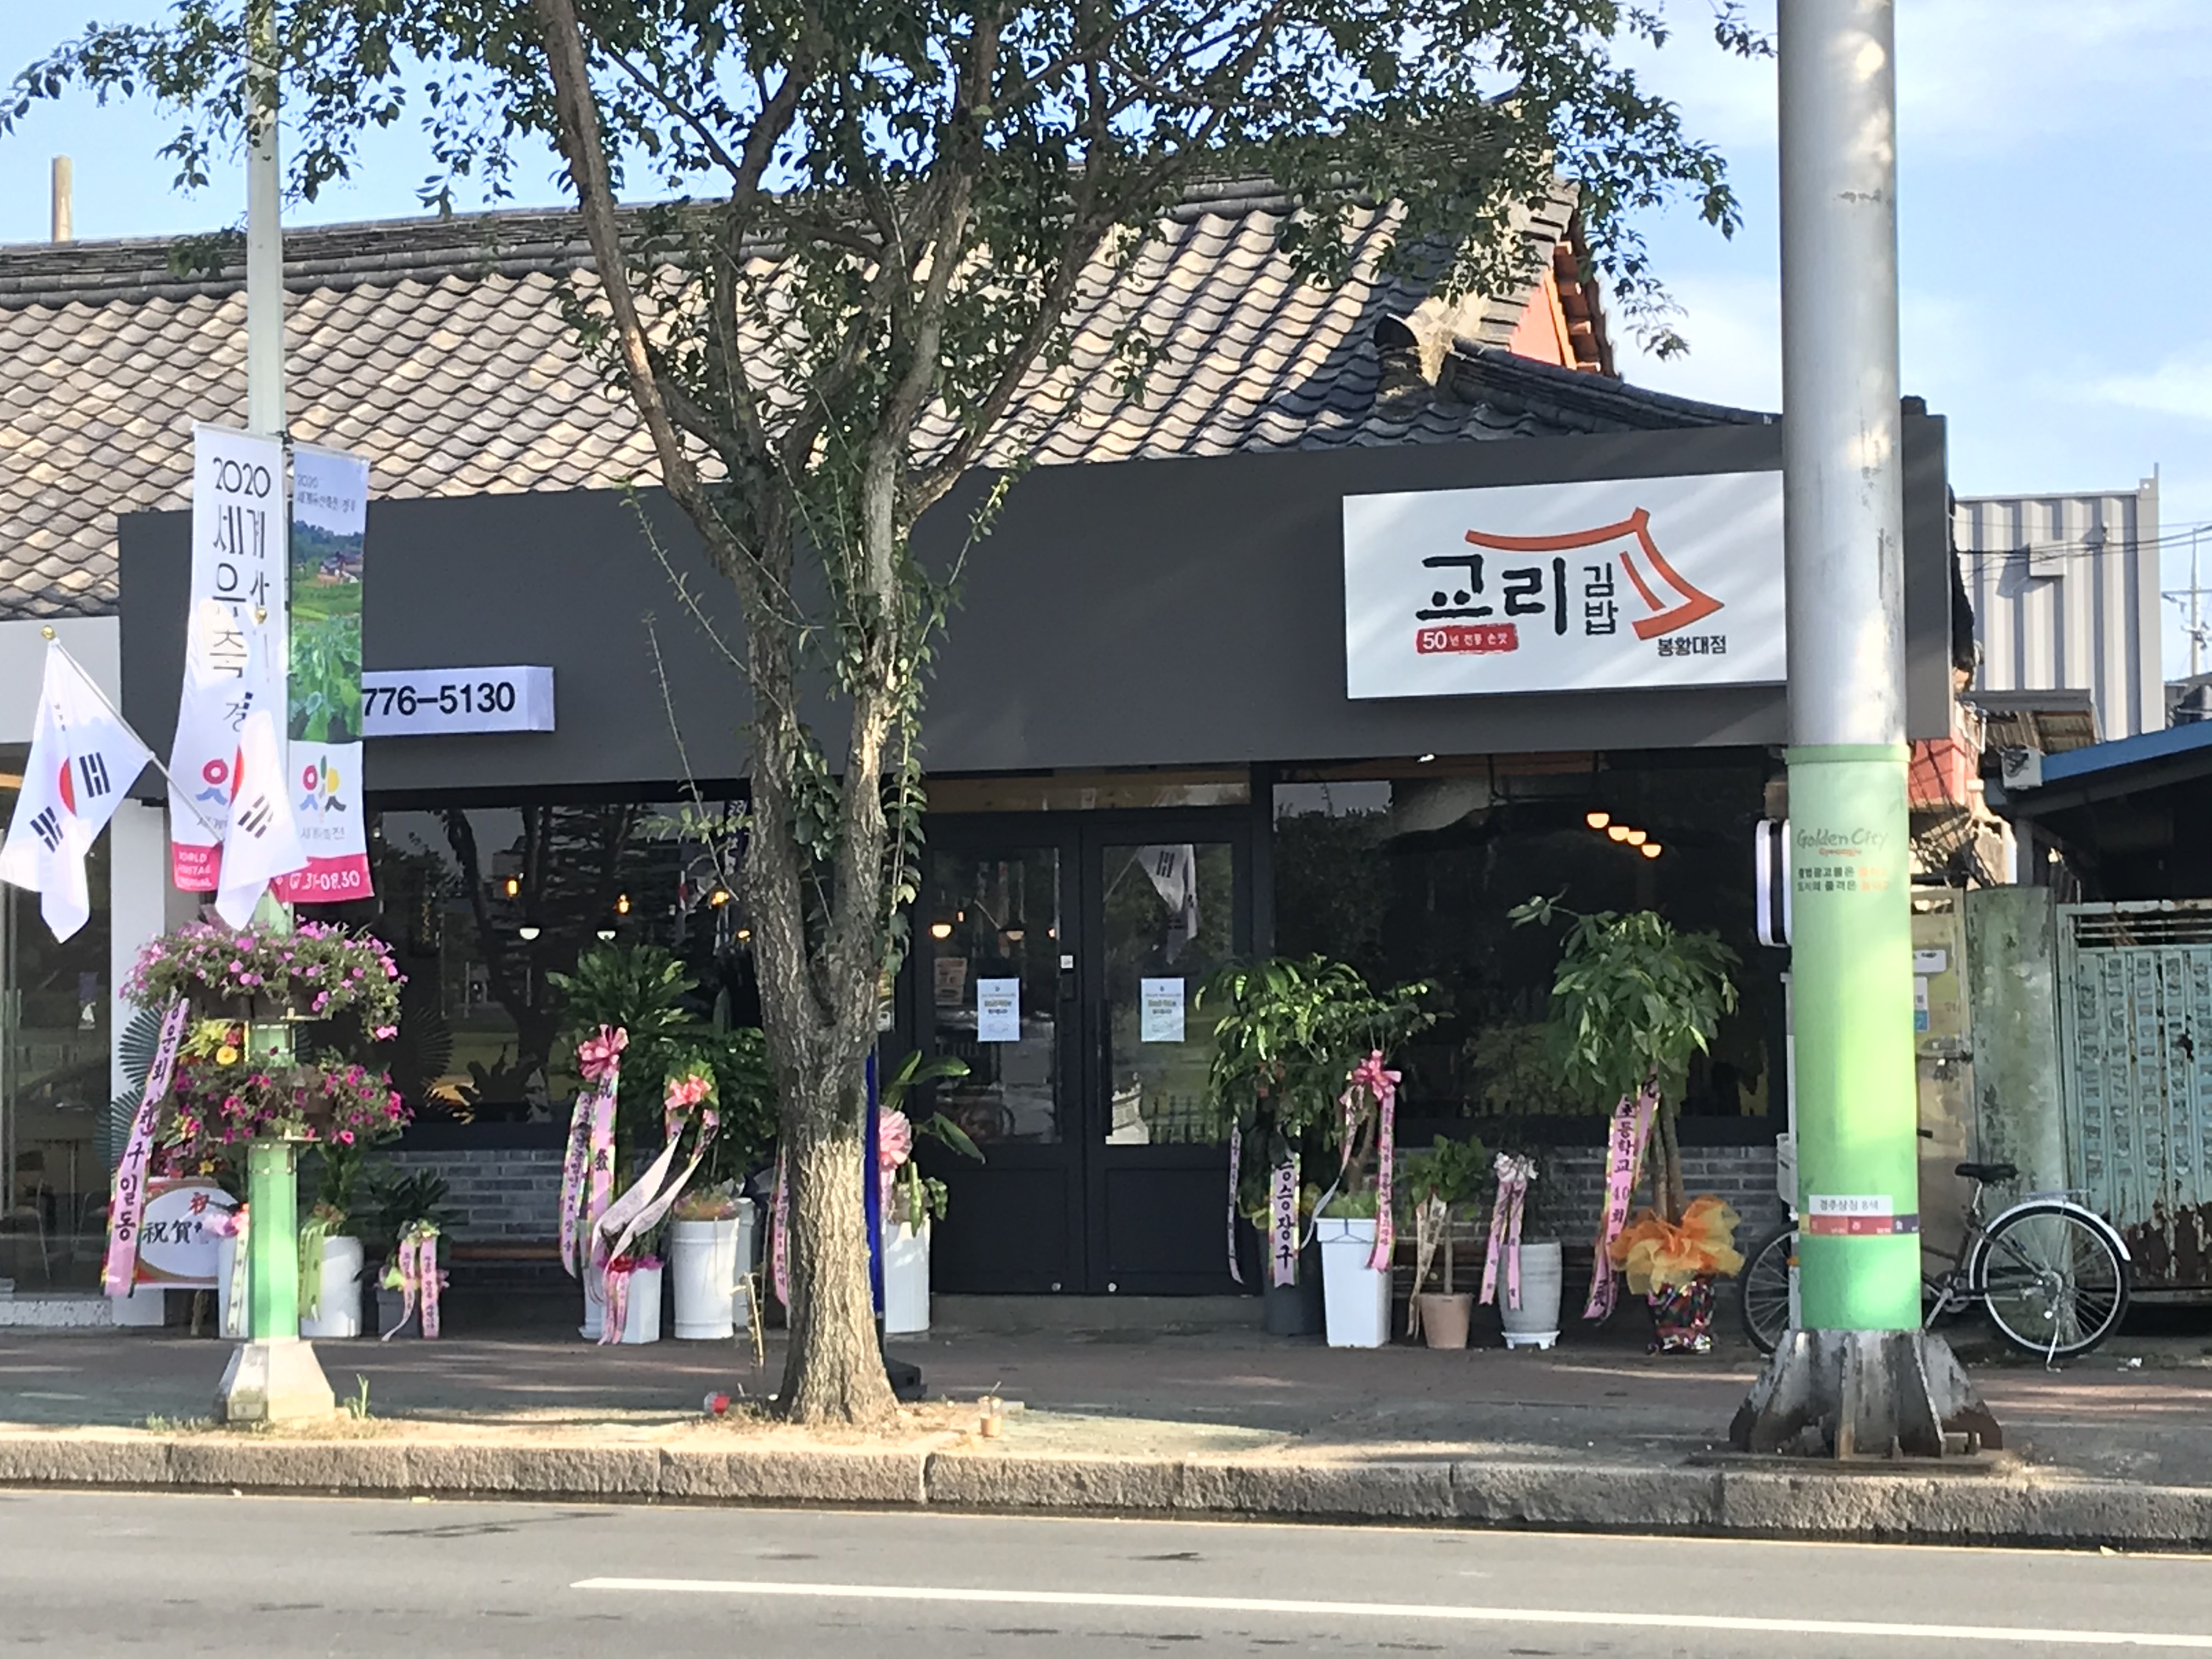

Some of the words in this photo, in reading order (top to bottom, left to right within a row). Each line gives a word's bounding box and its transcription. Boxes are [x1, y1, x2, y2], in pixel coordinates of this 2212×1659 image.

[212, 456, 272, 499] 2020
[297, 474, 319, 489] 2020
[212, 504, 266, 560] 세계
[1415, 553, 1568, 636] 교리
[1583, 561, 1619, 636] 김밥
[1657, 635, 1726, 657] 봉황대점
[362, 682, 516, 716] 776-5130
[1797, 827, 1849, 849] Golden
[1851, 827, 1889, 851] City
[142, 1220, 204, 1245] 祝賀
